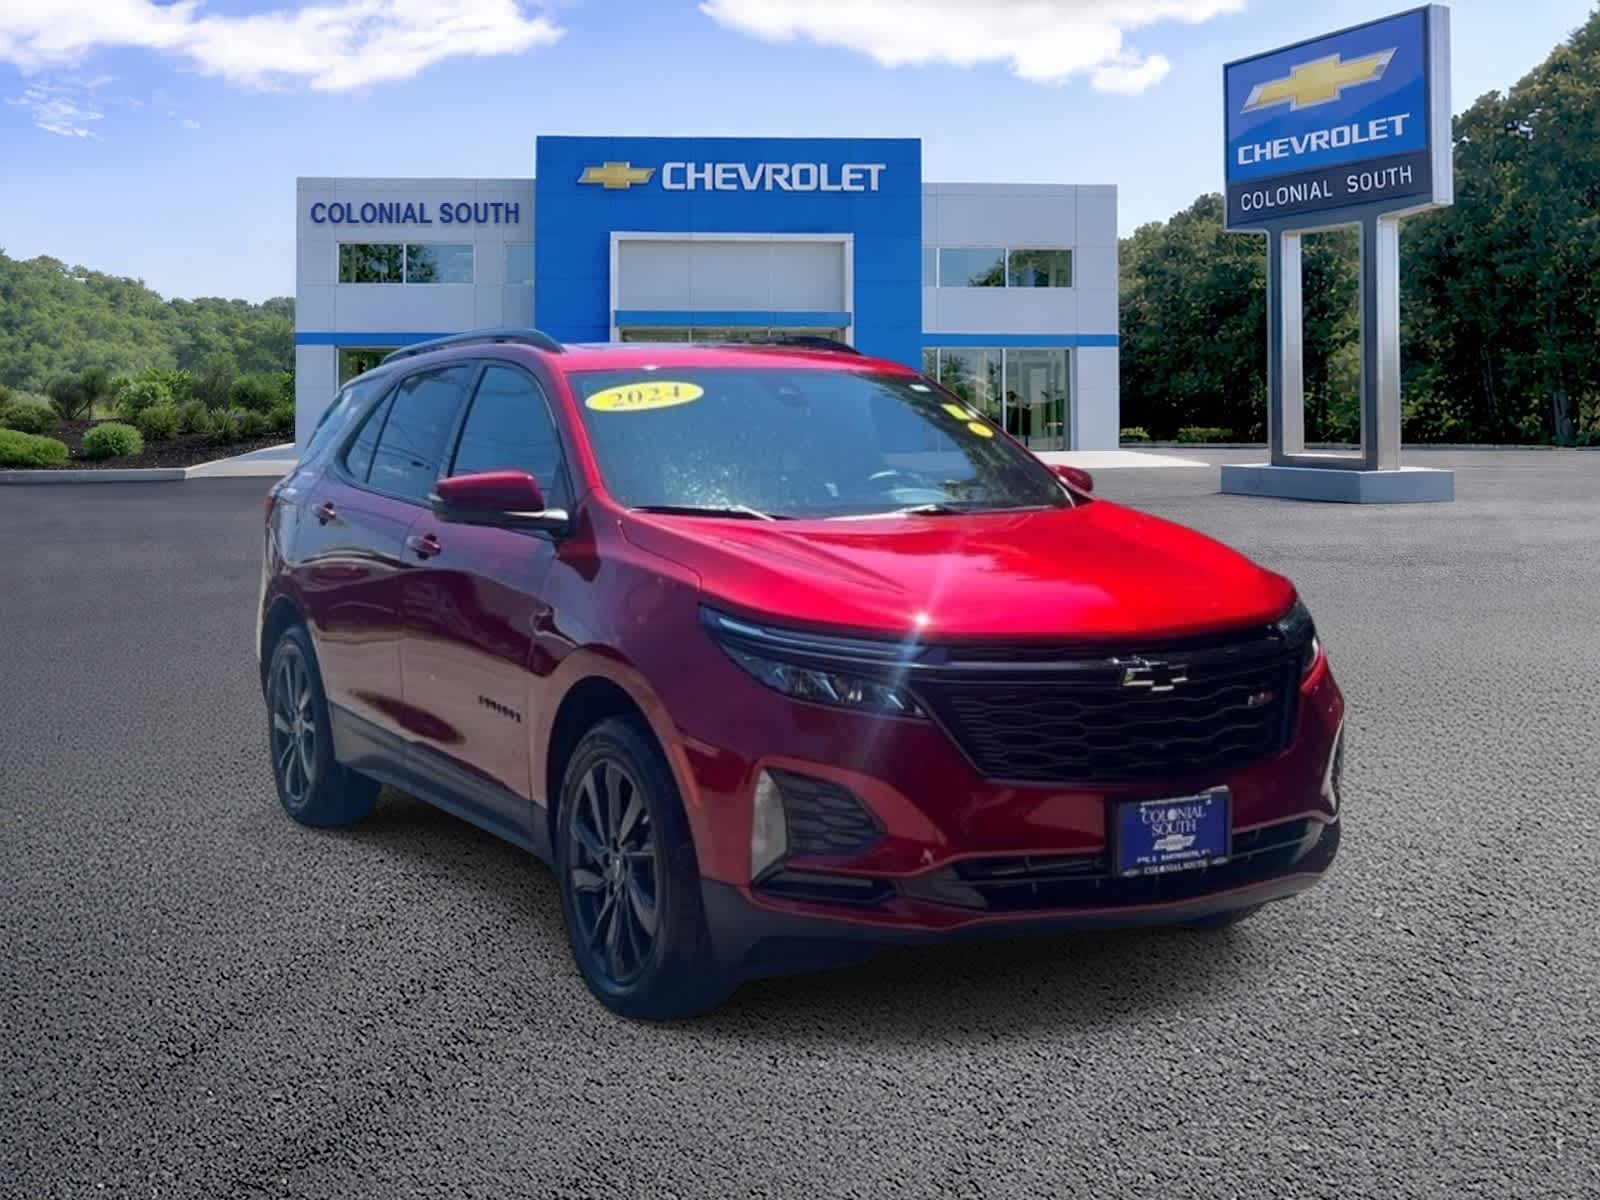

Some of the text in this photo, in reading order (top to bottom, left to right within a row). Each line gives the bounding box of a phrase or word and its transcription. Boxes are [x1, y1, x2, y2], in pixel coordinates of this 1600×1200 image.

[1237, 113, 1410, 166] CHEVROLET
[661, 161, 887, 192] CHEVROLET
[1241, 165, 1413, 212] COLONIAL SOUTH
[310, 202, 521, 225] COLONIAL SOUTH
[611, 384, 681, 408] 2024
[1141, 806, 1206, 825] COLONIAL
[1151, 818, 1198, 836] SOUTH
